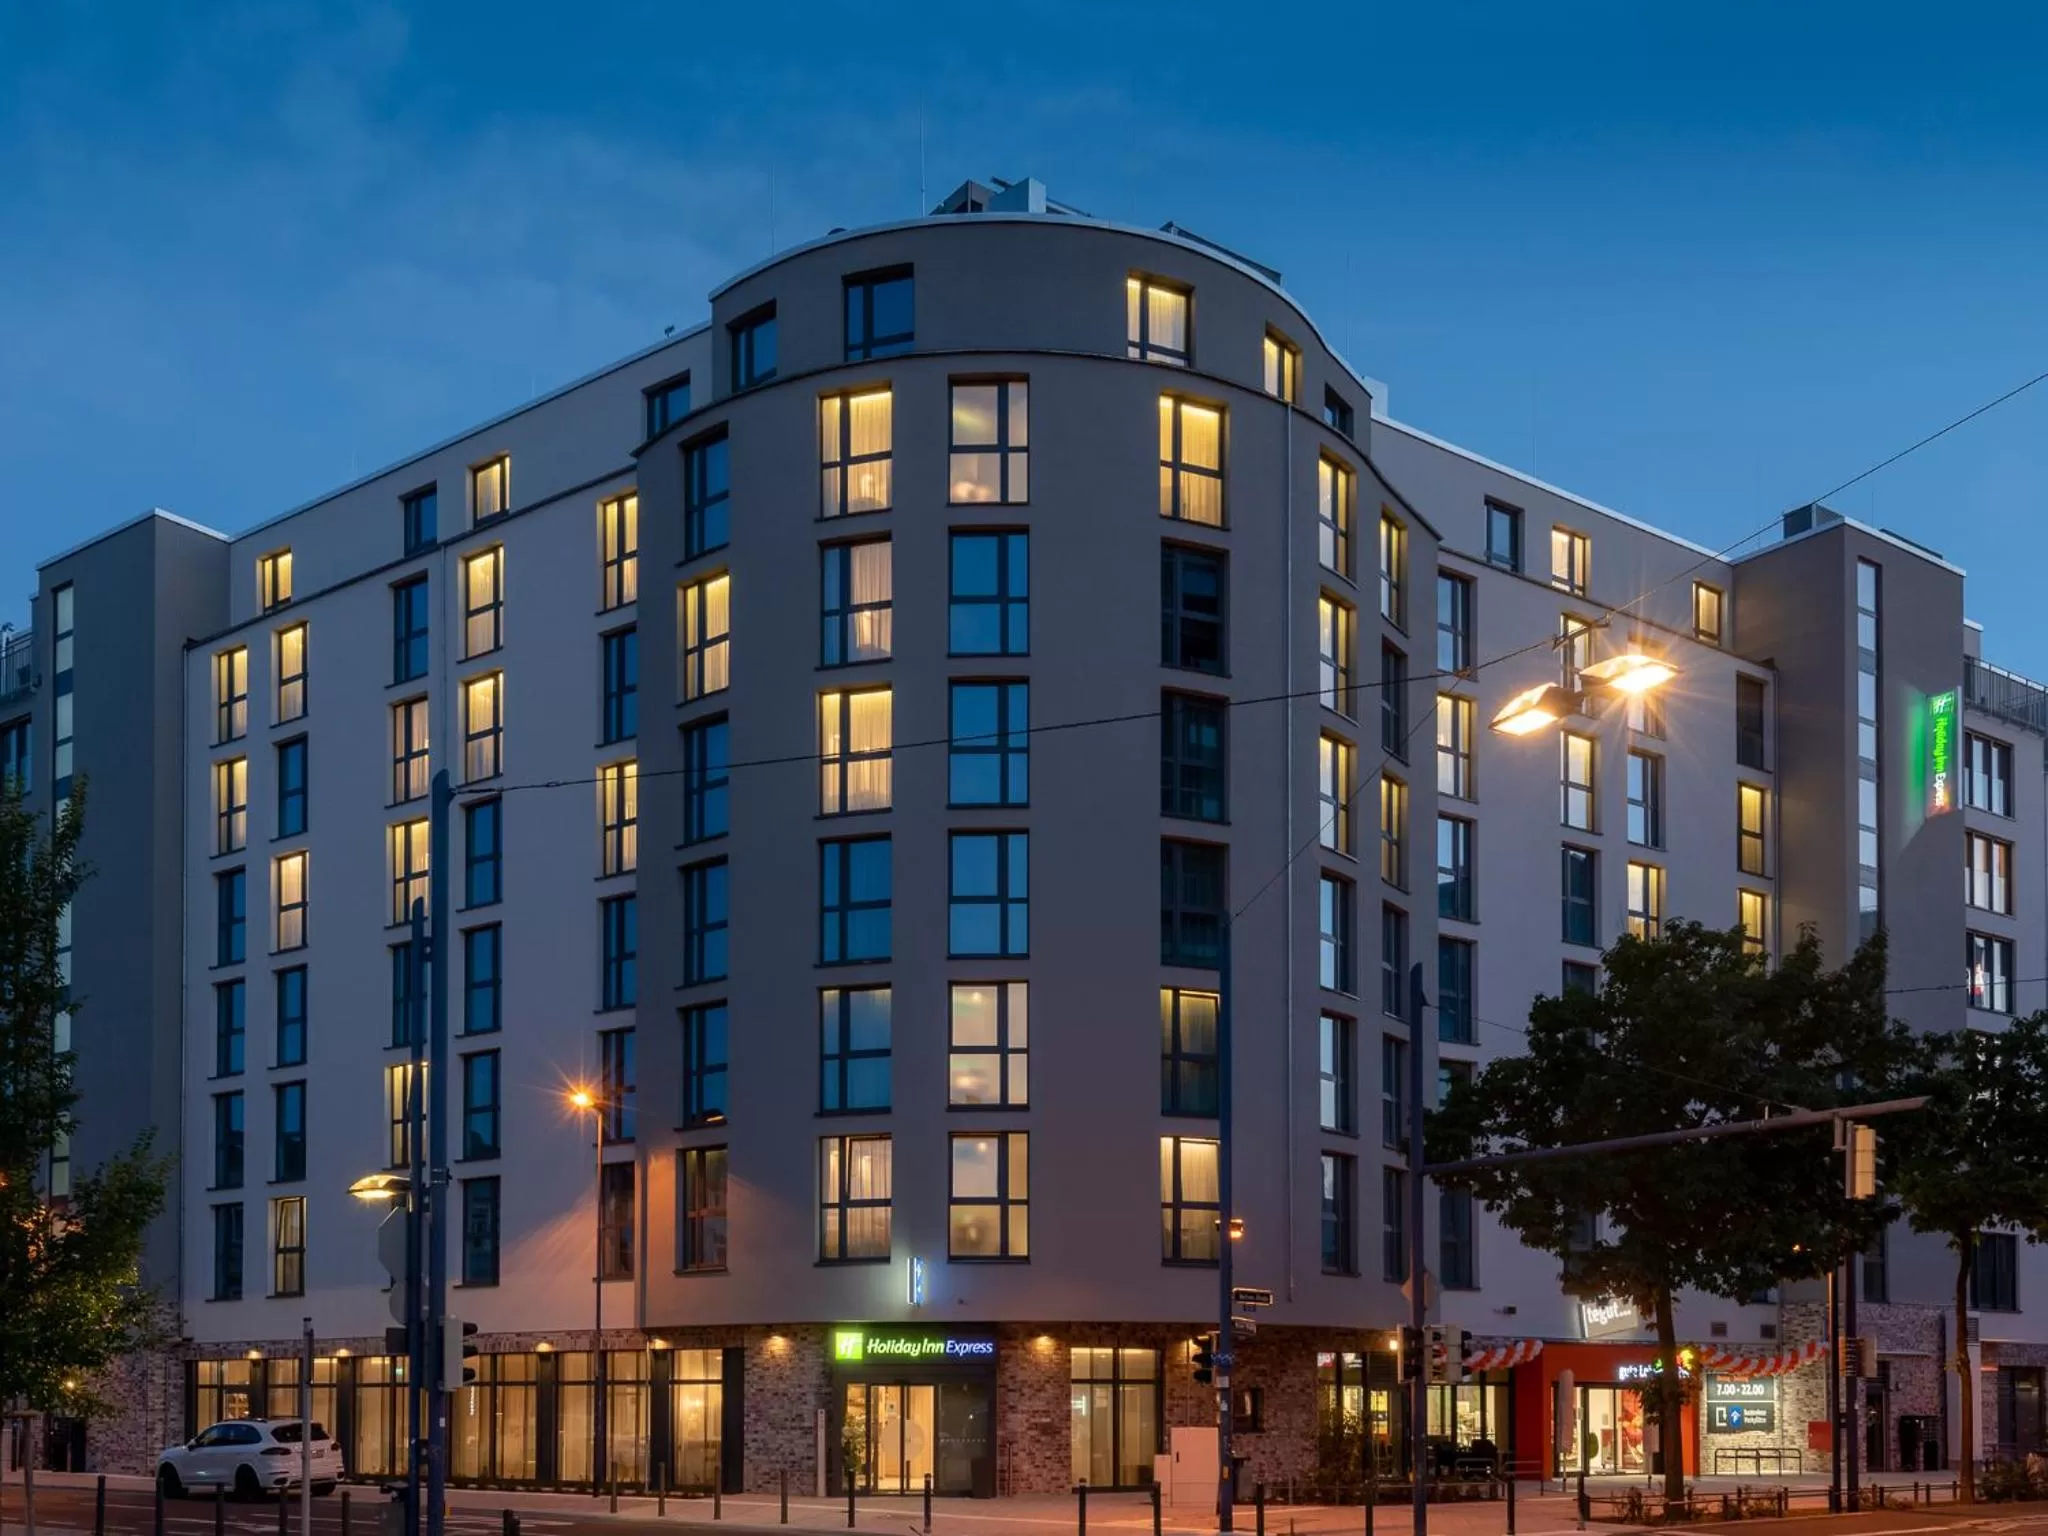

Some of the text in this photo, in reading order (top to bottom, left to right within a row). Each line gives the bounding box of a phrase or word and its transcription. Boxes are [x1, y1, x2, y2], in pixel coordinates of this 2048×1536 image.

[867, 1338, 993, 1356] Holiday Inn Express
[1717, 1384, 1735, 1396] 7.00
[1741, 1384, 1764, 1396] 22.00
